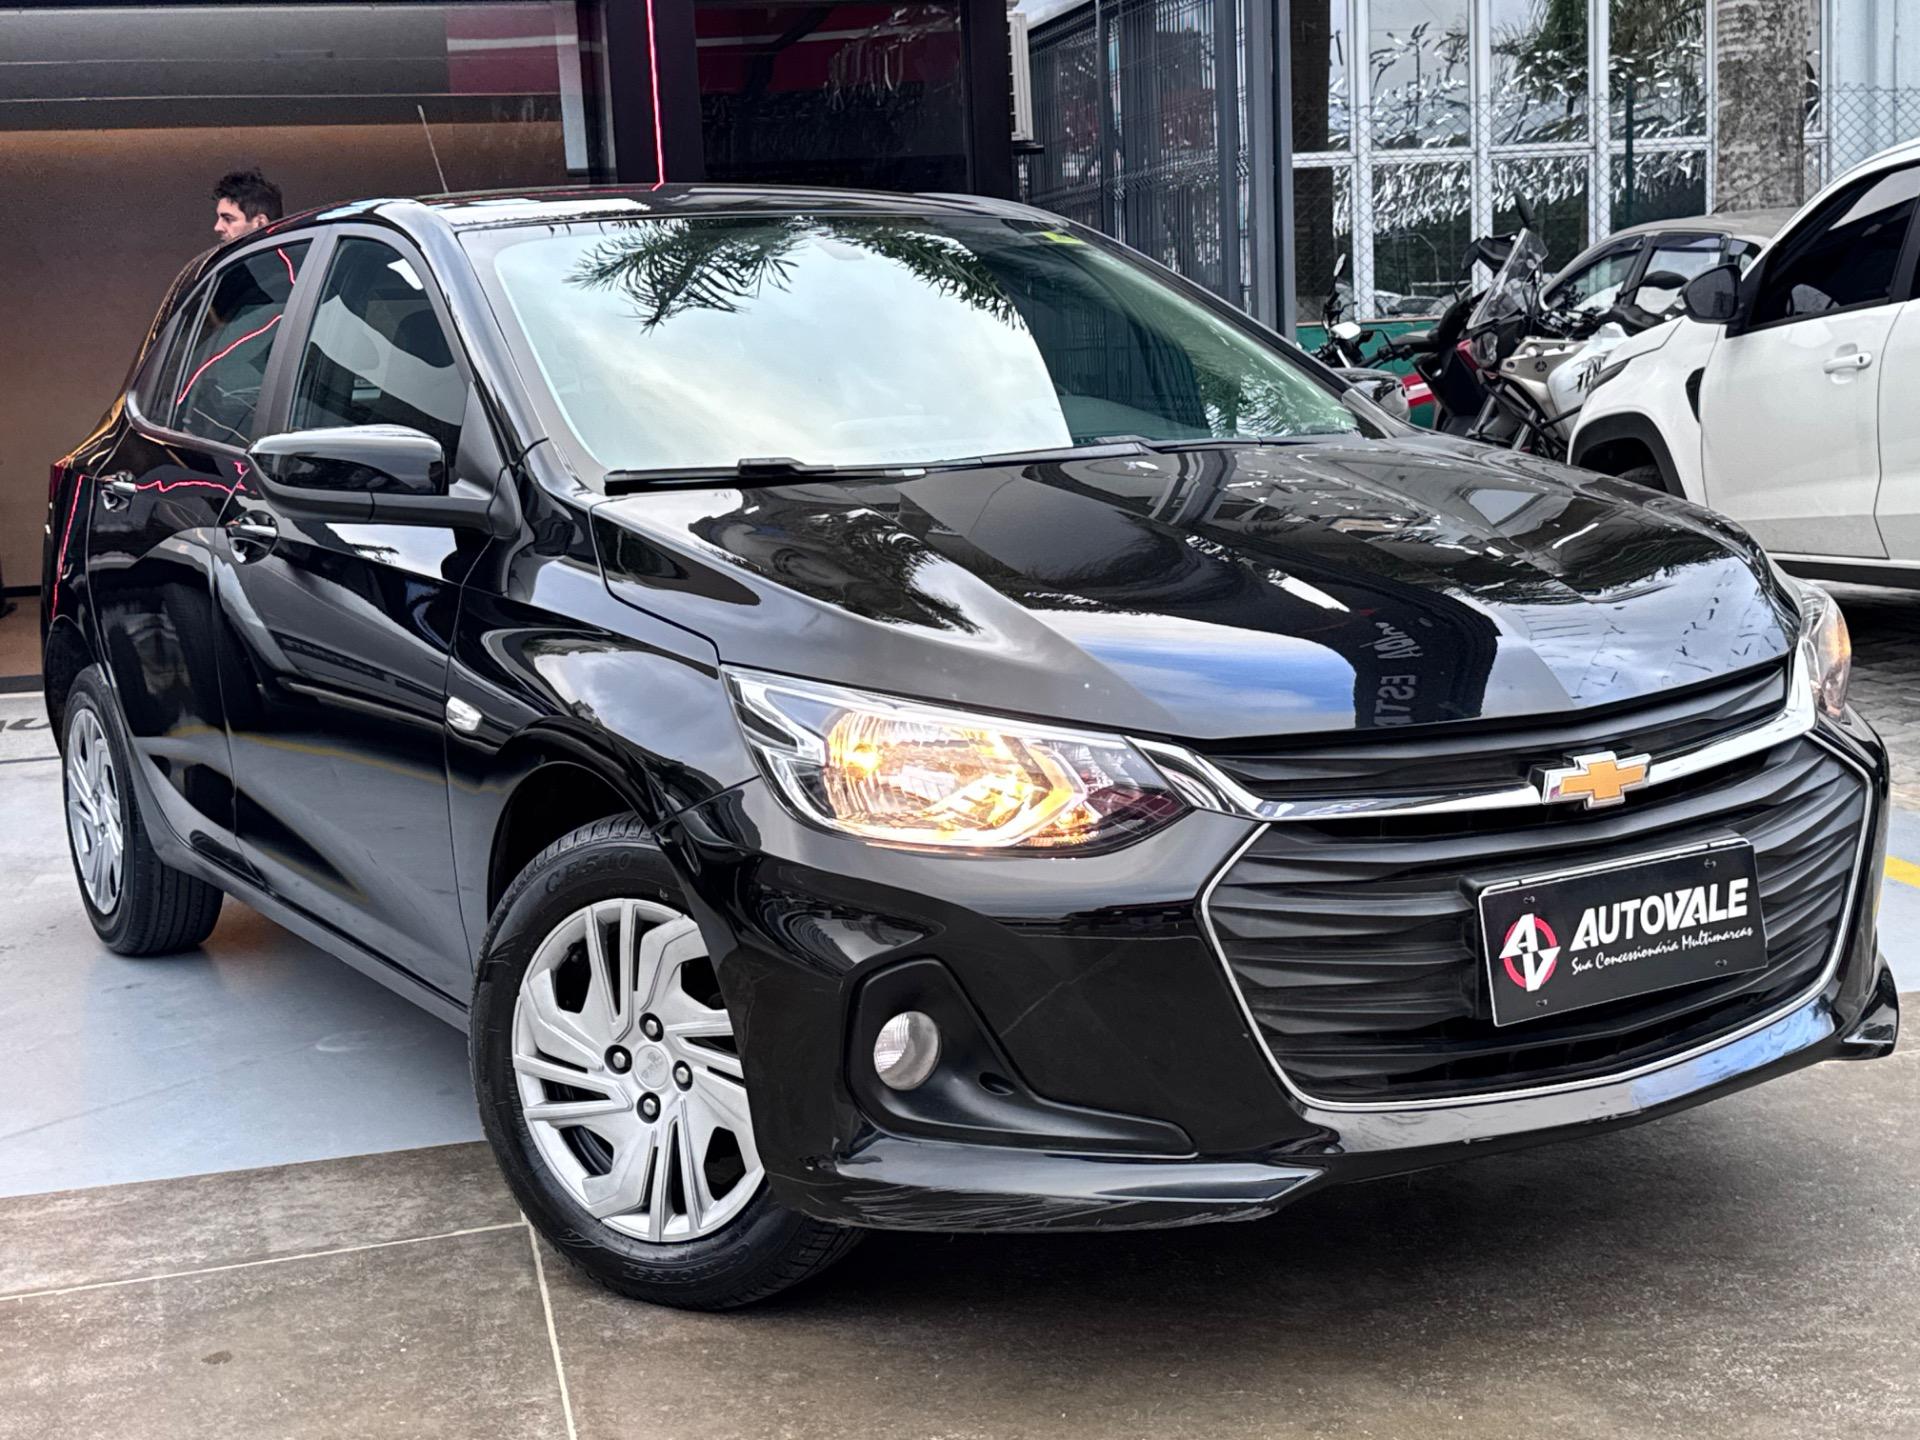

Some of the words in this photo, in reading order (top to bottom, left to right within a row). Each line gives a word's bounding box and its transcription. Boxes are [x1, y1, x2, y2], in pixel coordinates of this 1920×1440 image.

[1569, 877, 1749, 951] AUTOVALE
[1571, 956, 1594, 976] Sua
[1595, 940, 1679, 970] Concessionária
[1681, 926, 1754, 951] Multimarcas
